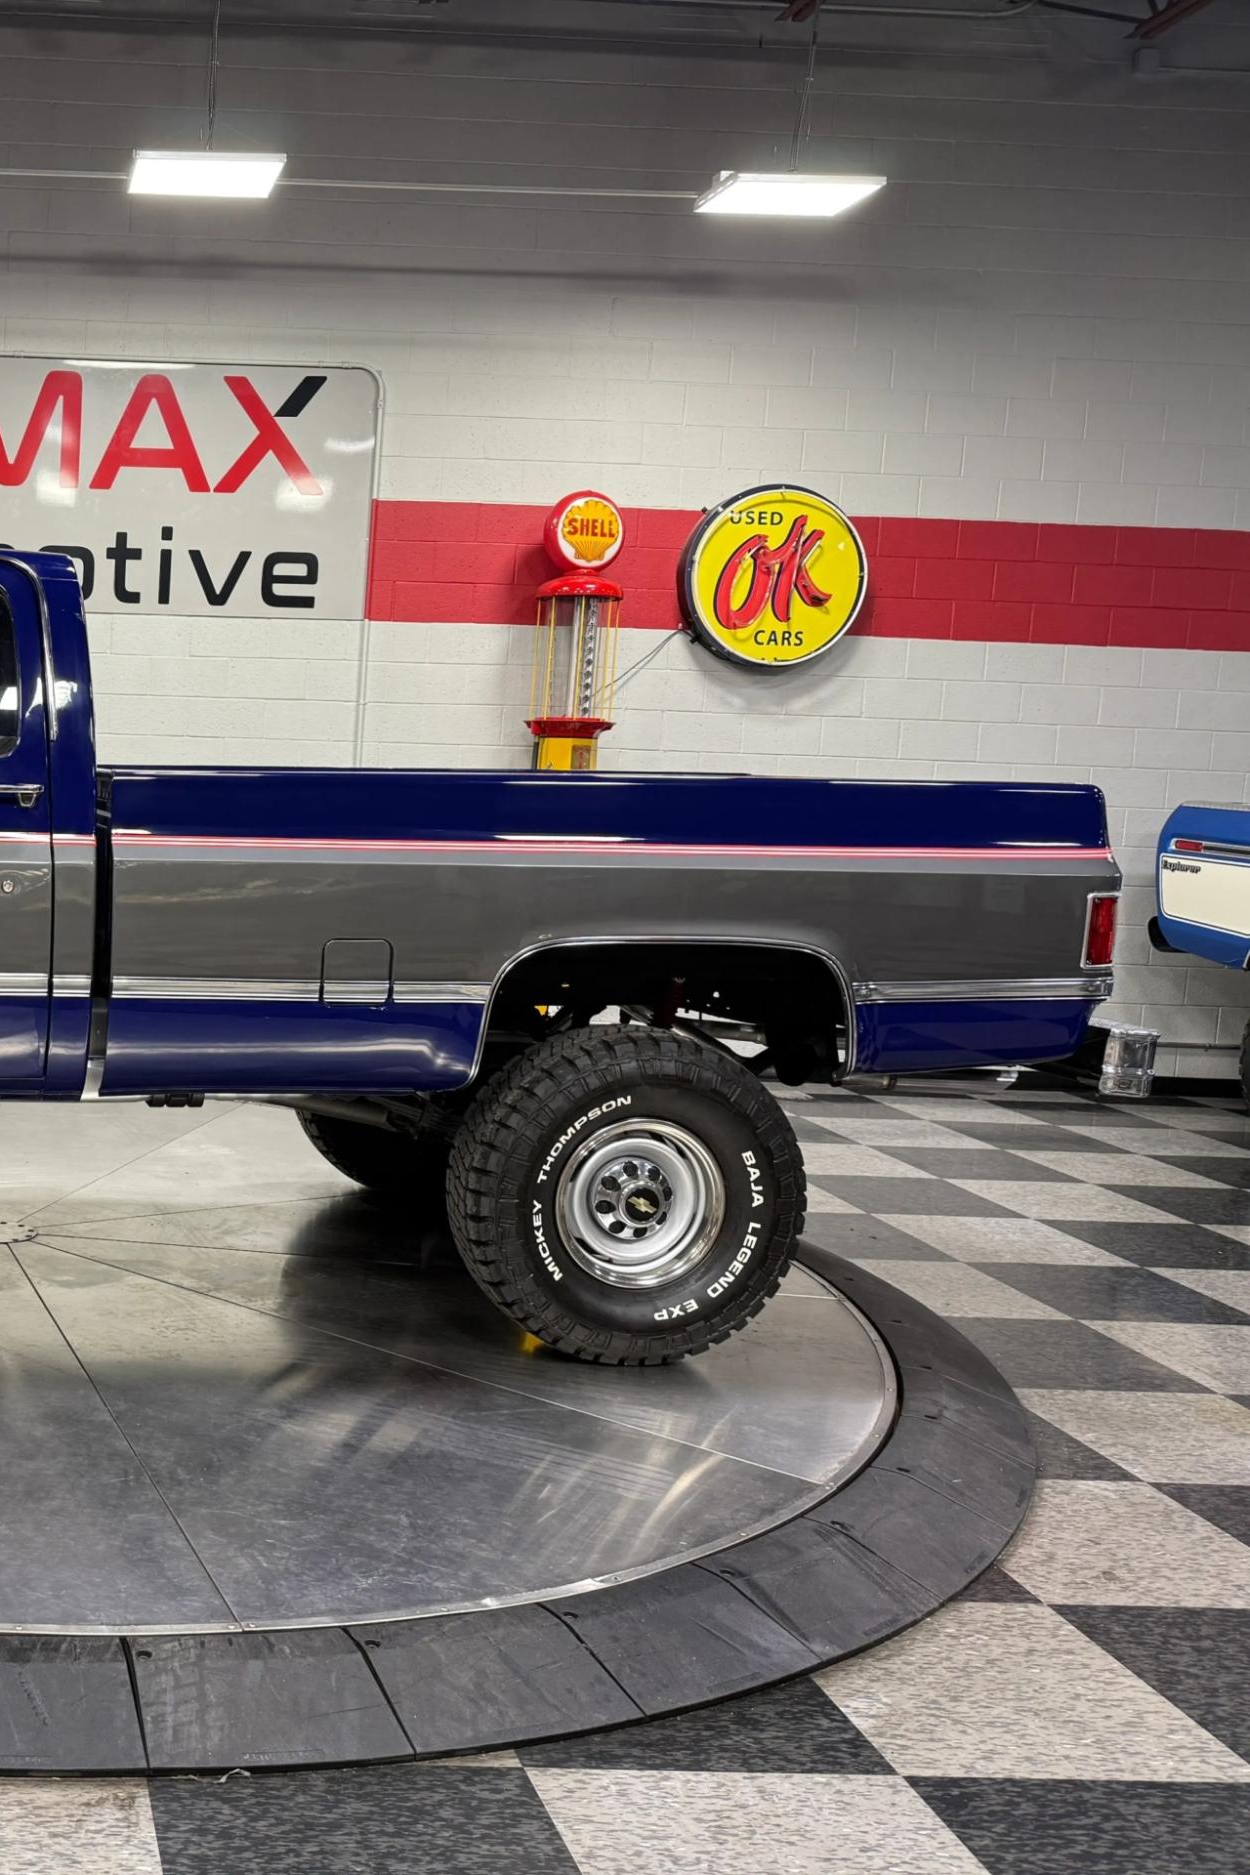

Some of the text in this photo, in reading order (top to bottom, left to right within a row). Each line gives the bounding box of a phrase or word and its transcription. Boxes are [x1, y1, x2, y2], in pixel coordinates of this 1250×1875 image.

[567, 518, 616, 538] SHELL
[729, 509, 783, 526] USED
[713, 513, 832, 631] OK
[753, 630, 804, 647] CARS
[532, 1095, 632, 1283] MICKEY THOMPSON
[653, 1149, 765, 1322] BAJA LEGEND EXP
